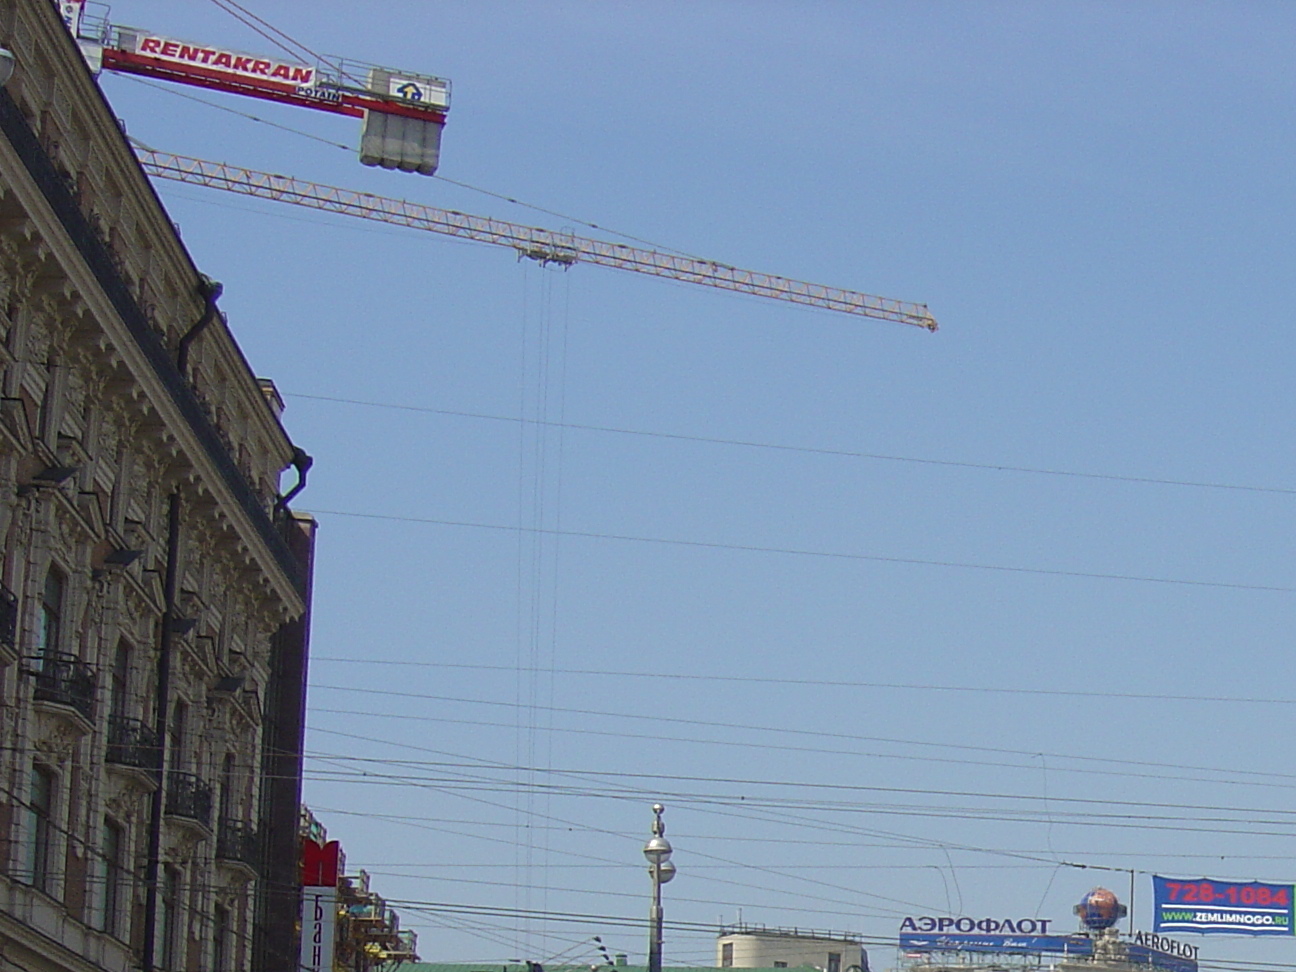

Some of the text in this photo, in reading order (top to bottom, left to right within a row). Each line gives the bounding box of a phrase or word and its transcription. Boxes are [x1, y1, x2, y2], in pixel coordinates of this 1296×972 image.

[140, 37, 313, 84] RENTAKRAN
[296, 86, 342, 102] POTAIN
[1165, 882, 1289, 906] 728-1084
[899, 916, 1052, 935] АЭРОФЛОТ
[1161, 911, 1289, 925] WWW.ZEMLIMNOGO.RU
[1134, 930, 1200, 961] AEROFLOT
